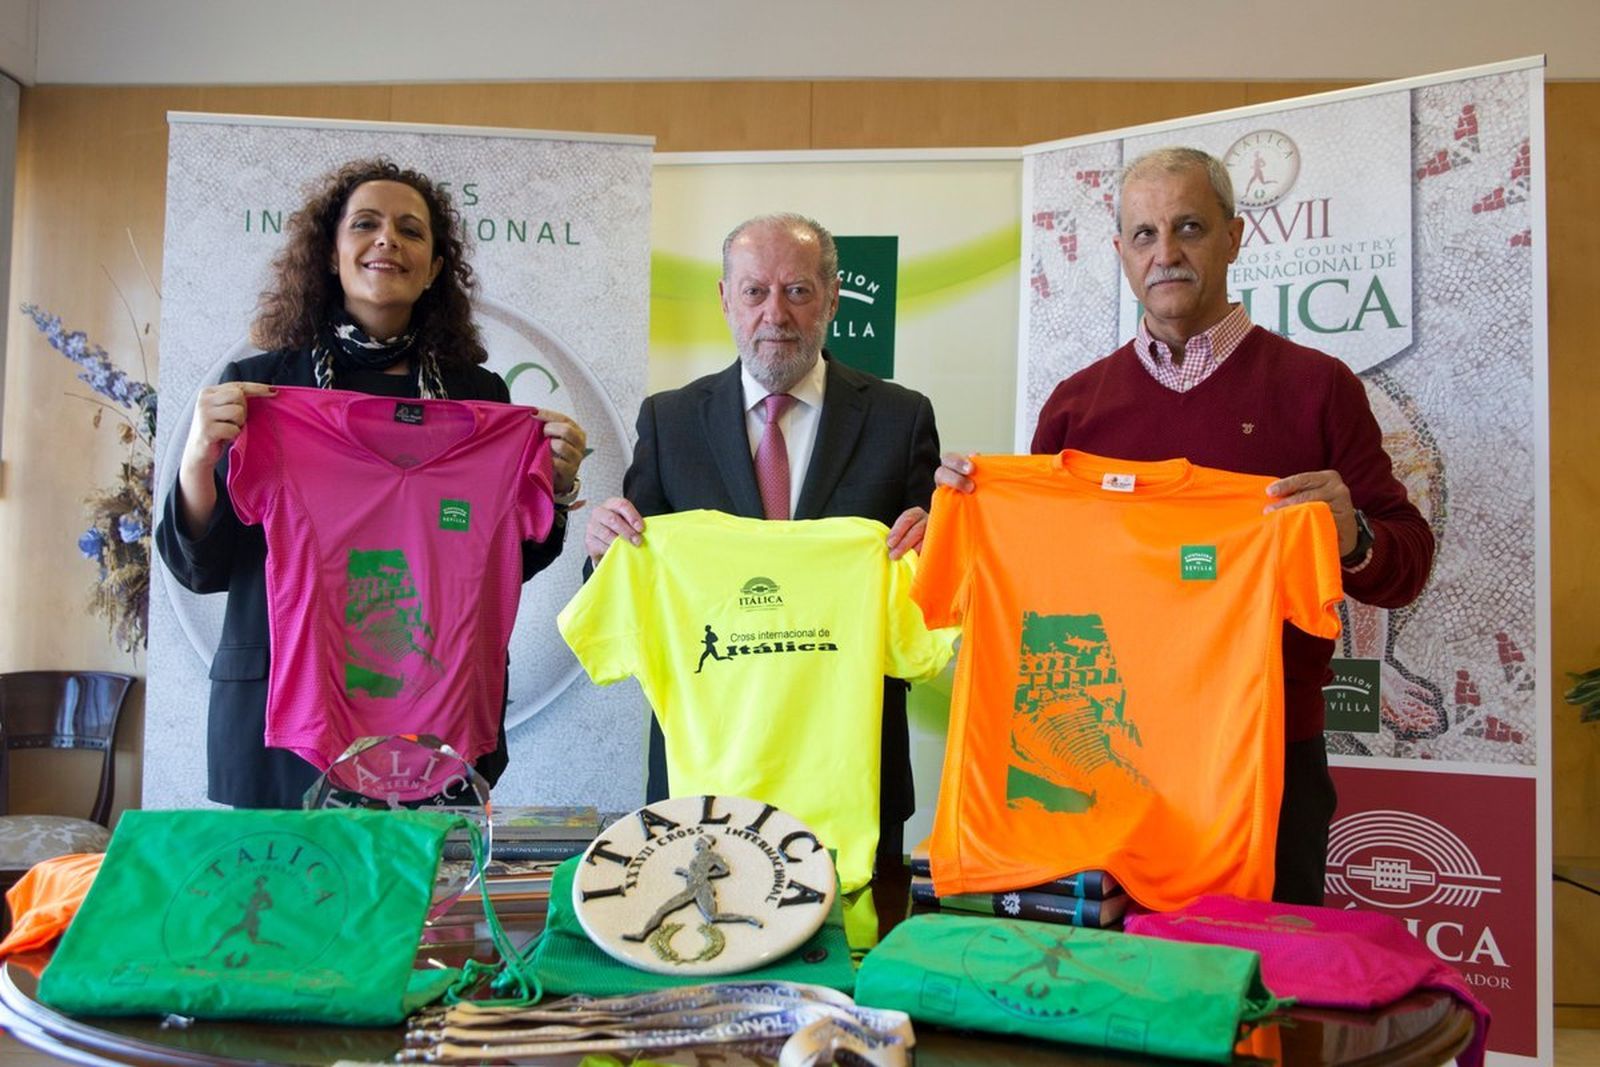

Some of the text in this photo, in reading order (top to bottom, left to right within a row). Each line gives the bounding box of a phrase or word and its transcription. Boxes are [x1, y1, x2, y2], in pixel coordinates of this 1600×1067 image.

[245, 209, 581, 246] INIONAL
[1236, 197, 1333, 248] XVII
[1236, 238, 1396, 266] ROSS COUNTRY
[1231, 252, 1397, 284] ERNACIONAL DE
[730, 628, 831, 642] Cross internacional de
[727, 641, 838, 656] Itálica
[1335, 674, 1373, 689] TACION
[1330, 702, 1371, 712] VILLA
[656, 826, 704, 847] CROSS
[582, 795, 826, 909] ITALICA
